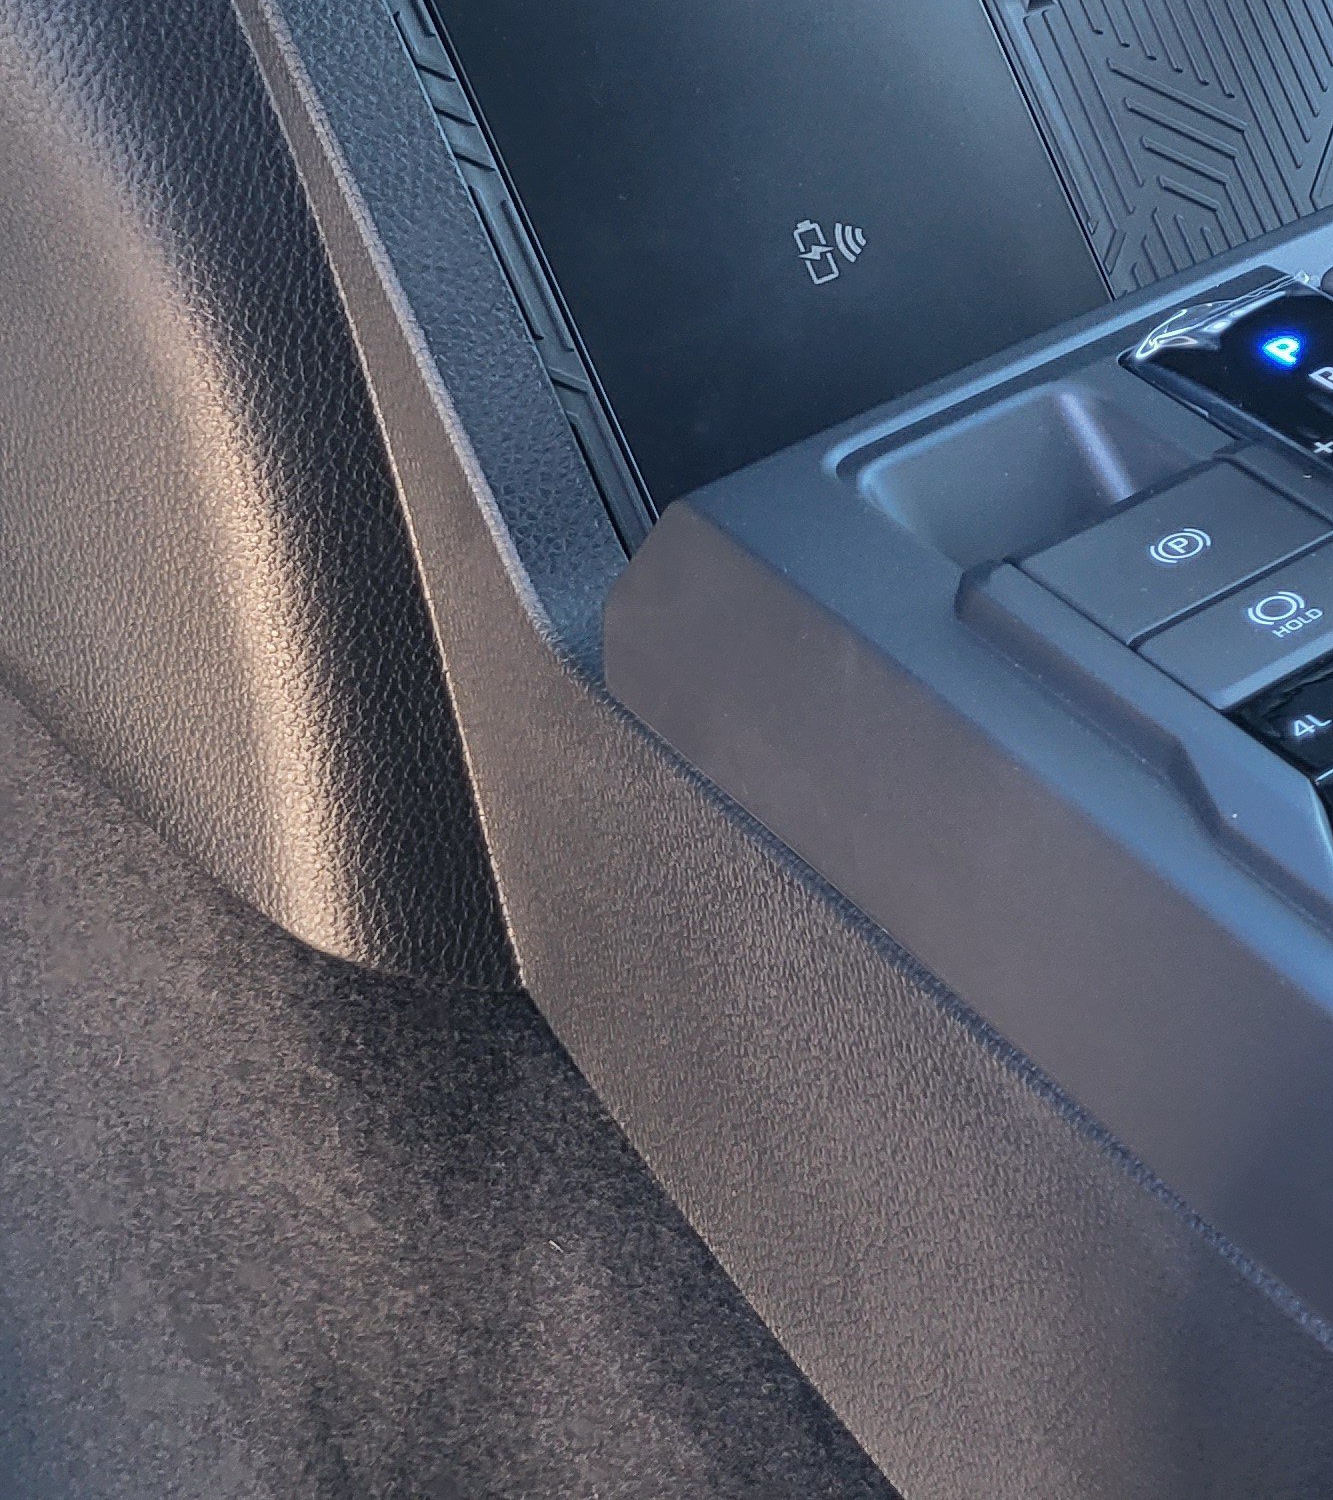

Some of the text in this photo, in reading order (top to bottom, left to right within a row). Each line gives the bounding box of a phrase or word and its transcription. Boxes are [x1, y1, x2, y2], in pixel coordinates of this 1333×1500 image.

[1264, 336, 1302, 363] P
[1271, 607, 1324, 639] HOLD
[1292, 713, 1332, 740] 4L
